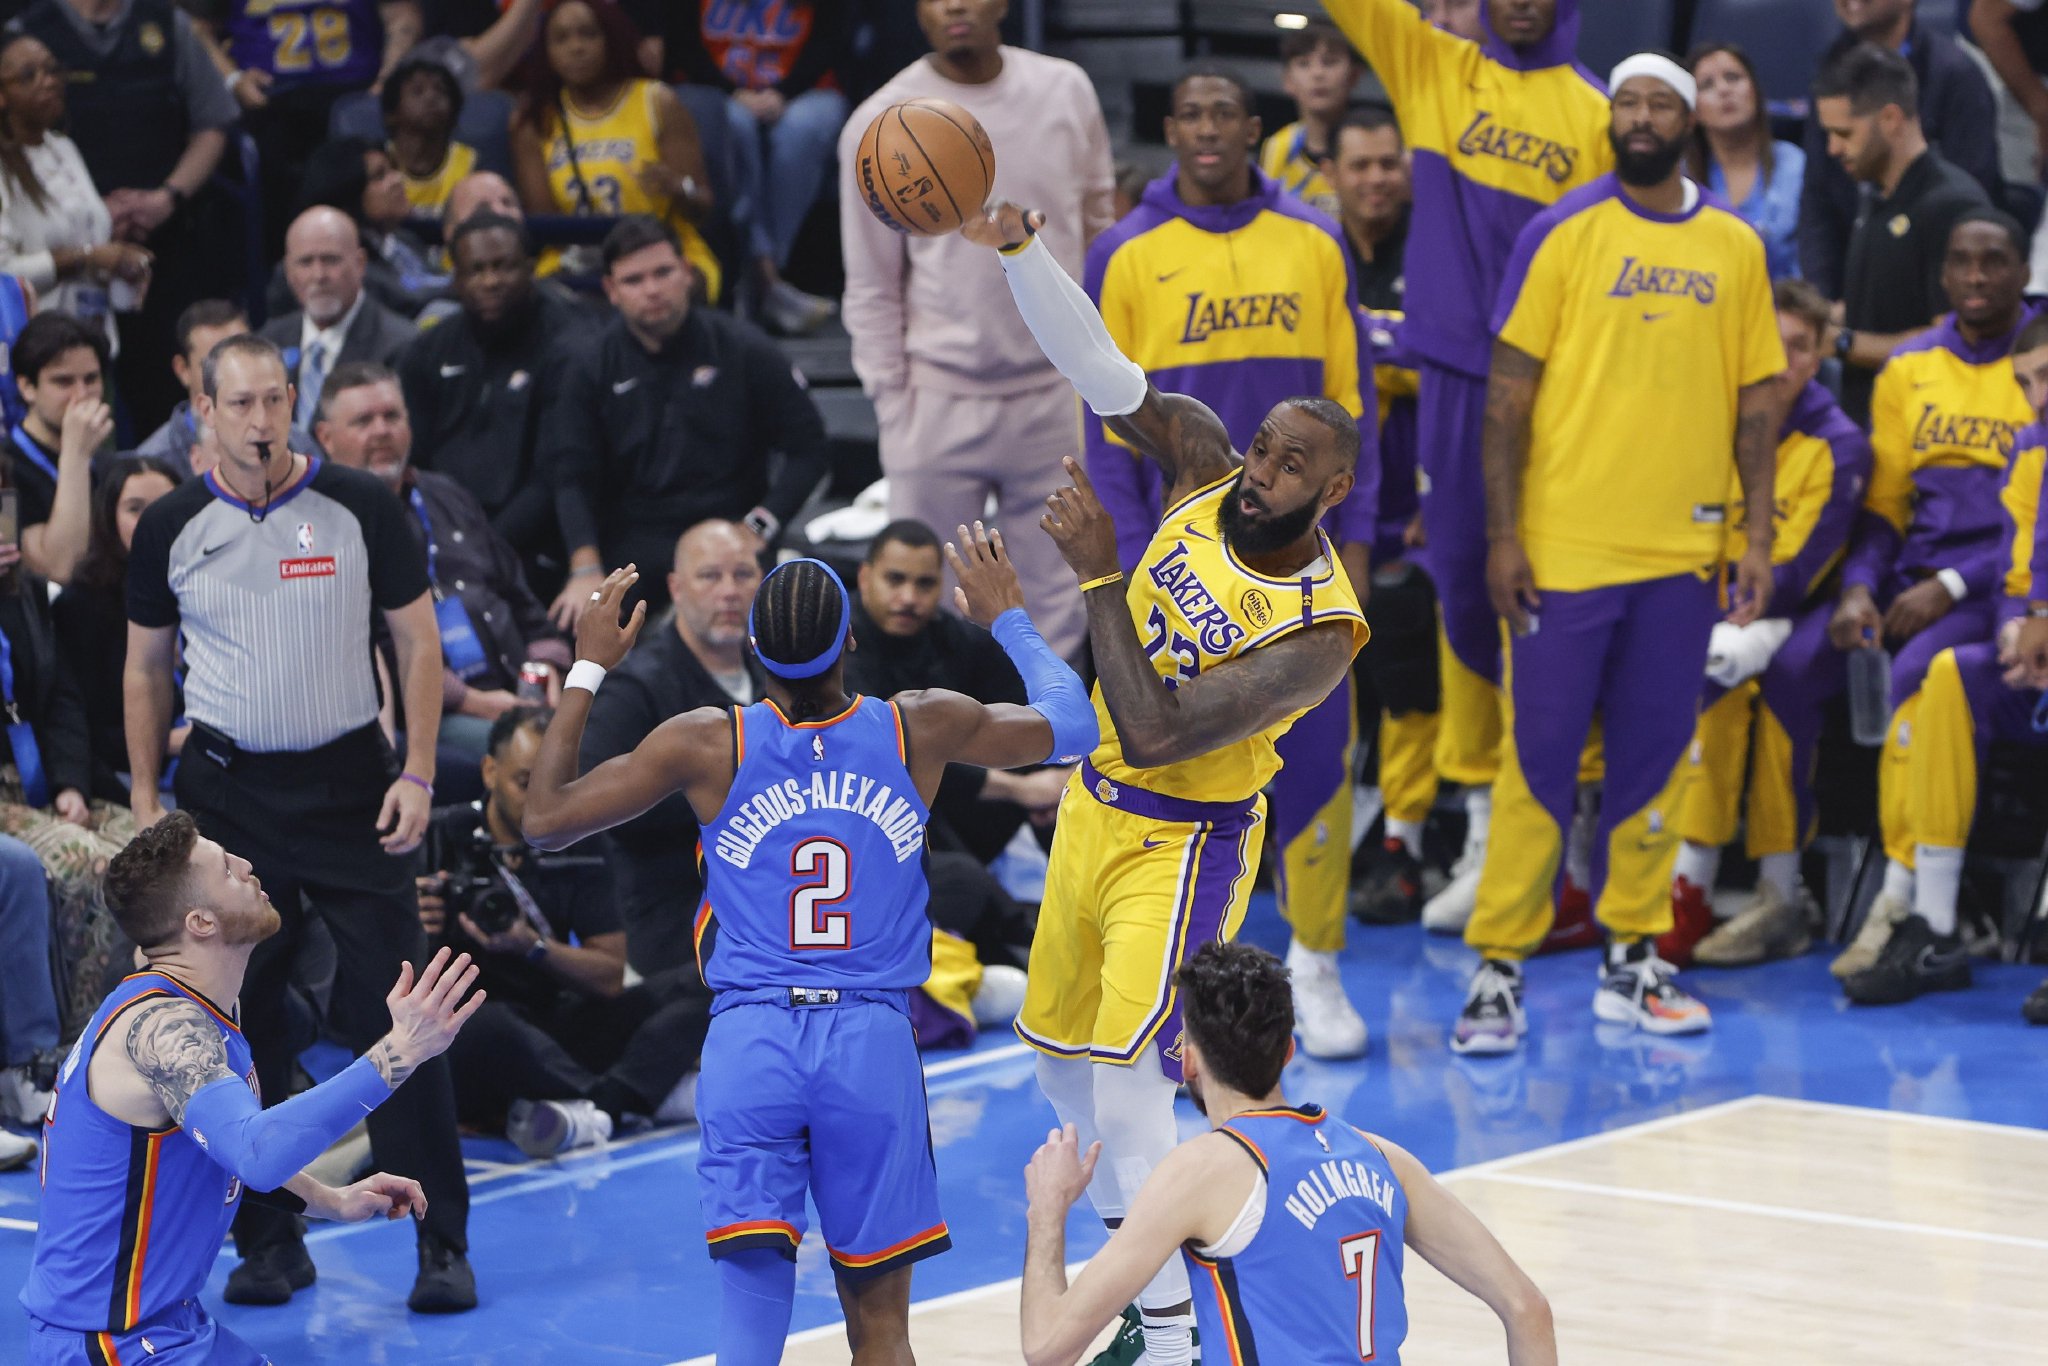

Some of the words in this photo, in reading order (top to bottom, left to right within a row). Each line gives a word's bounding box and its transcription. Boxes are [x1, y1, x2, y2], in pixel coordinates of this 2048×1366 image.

[267, 9, 351, 72] 28
[1457, 110, 1578, 183] LAKERS
[1607, 256, 1718, 304] LAKERS
[1179, 291, 1301, 344] LAKERS
[281, 560, 335, 577] Emirates
[1148, 540, 1246, 656] LAKERS
[1303, 594, 1312, 607] 44
[1247, 592, 1268, 626] bibigo
[715, 770, 925, 870] GILGEOUS-ALEXANDER
[789, 835, 851, 950] 2
[1284, 1159, 1395, 1232] HOLMGREN
[1338, 1228, 1382, 1363] 7
